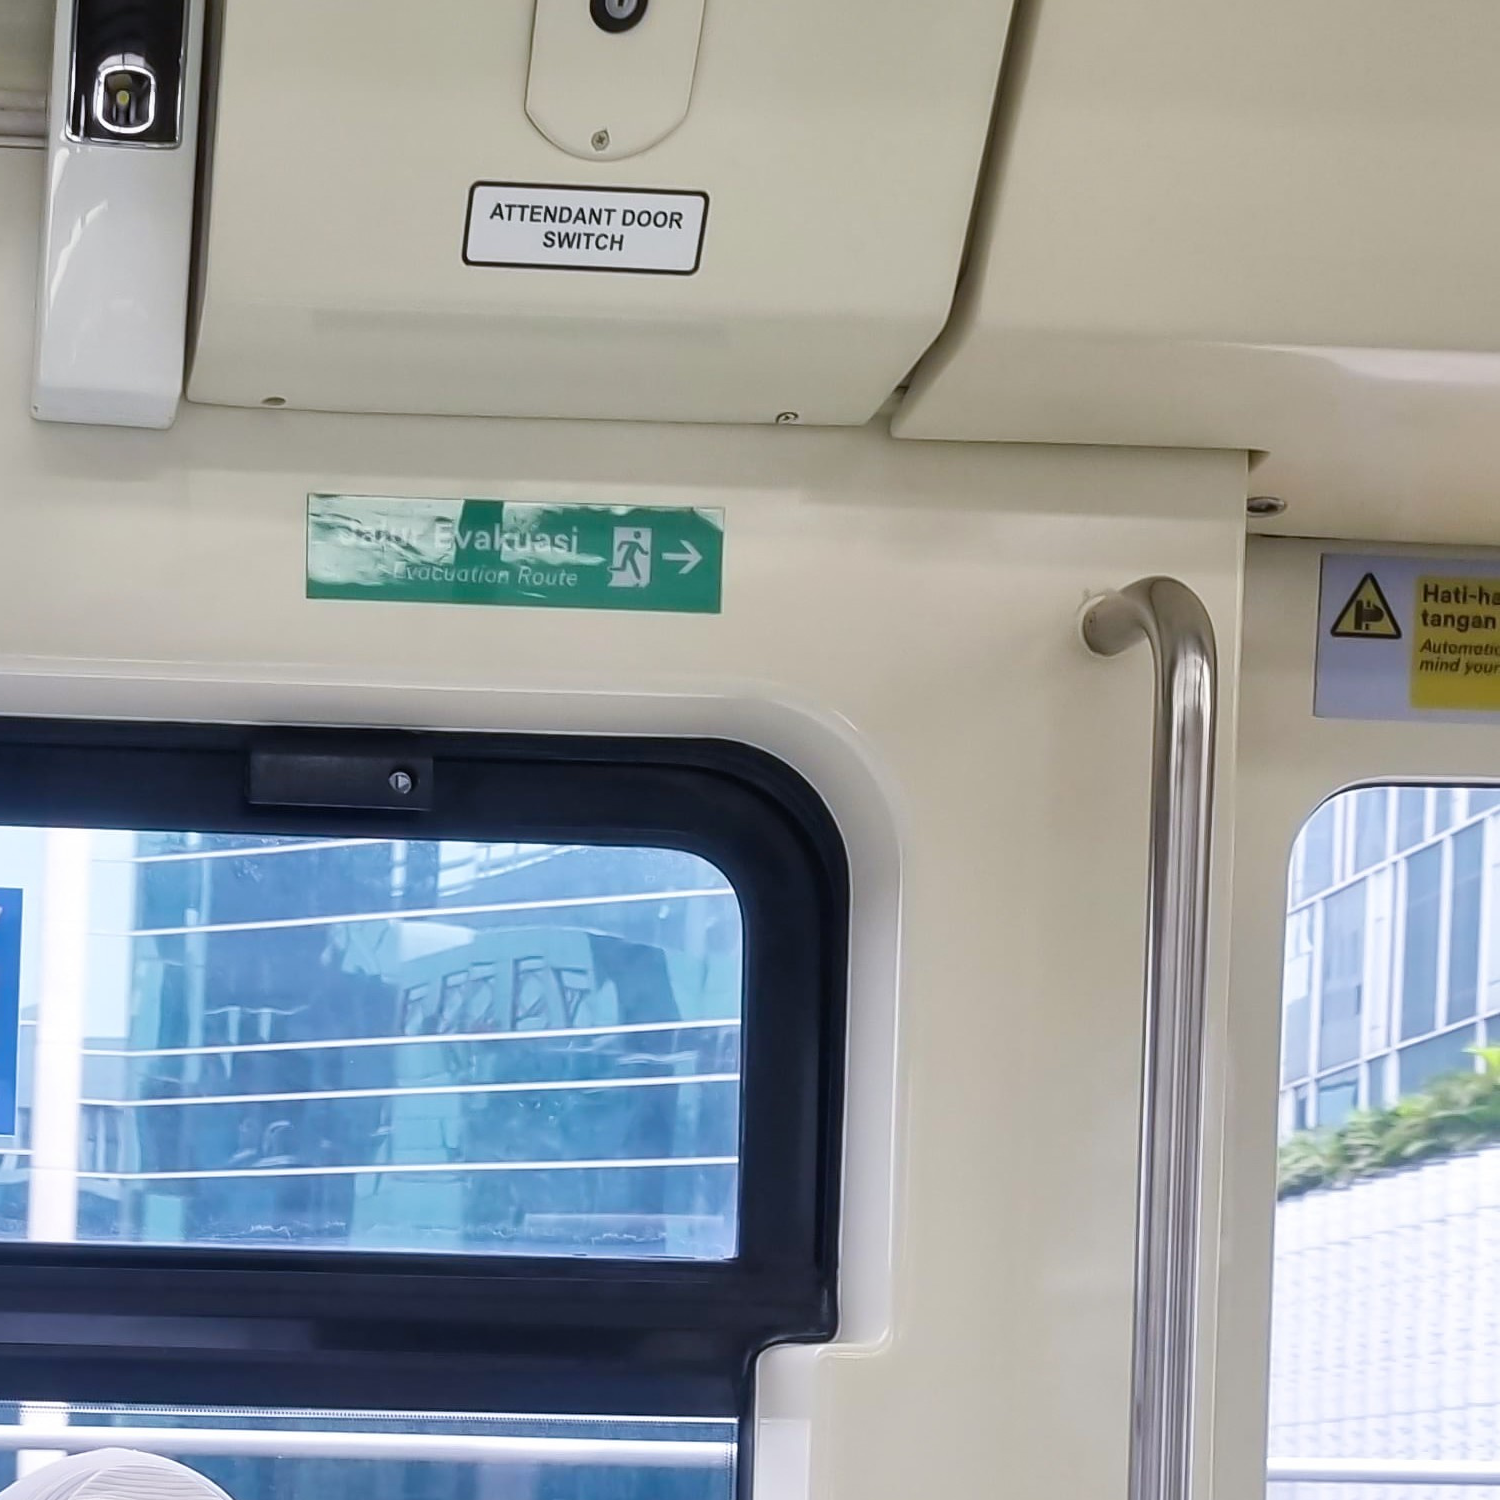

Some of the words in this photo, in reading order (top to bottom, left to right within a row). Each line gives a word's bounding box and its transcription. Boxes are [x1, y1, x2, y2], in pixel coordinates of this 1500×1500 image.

[489, 202, 616, 227] ATTENDANT
[621, 208, 683, 229] DOOR
[542, 230, 625, 252] SWITCH
[434, 522, 579, 554] Evakuasi
[394, 561, 509, 585] Evacuation
[518, 564, 578, 587] Route
[1421, 609, 1497, 633] tangan
[1419, 656, 1461, 672] mind
[1464, 660, 1500, 676] your
